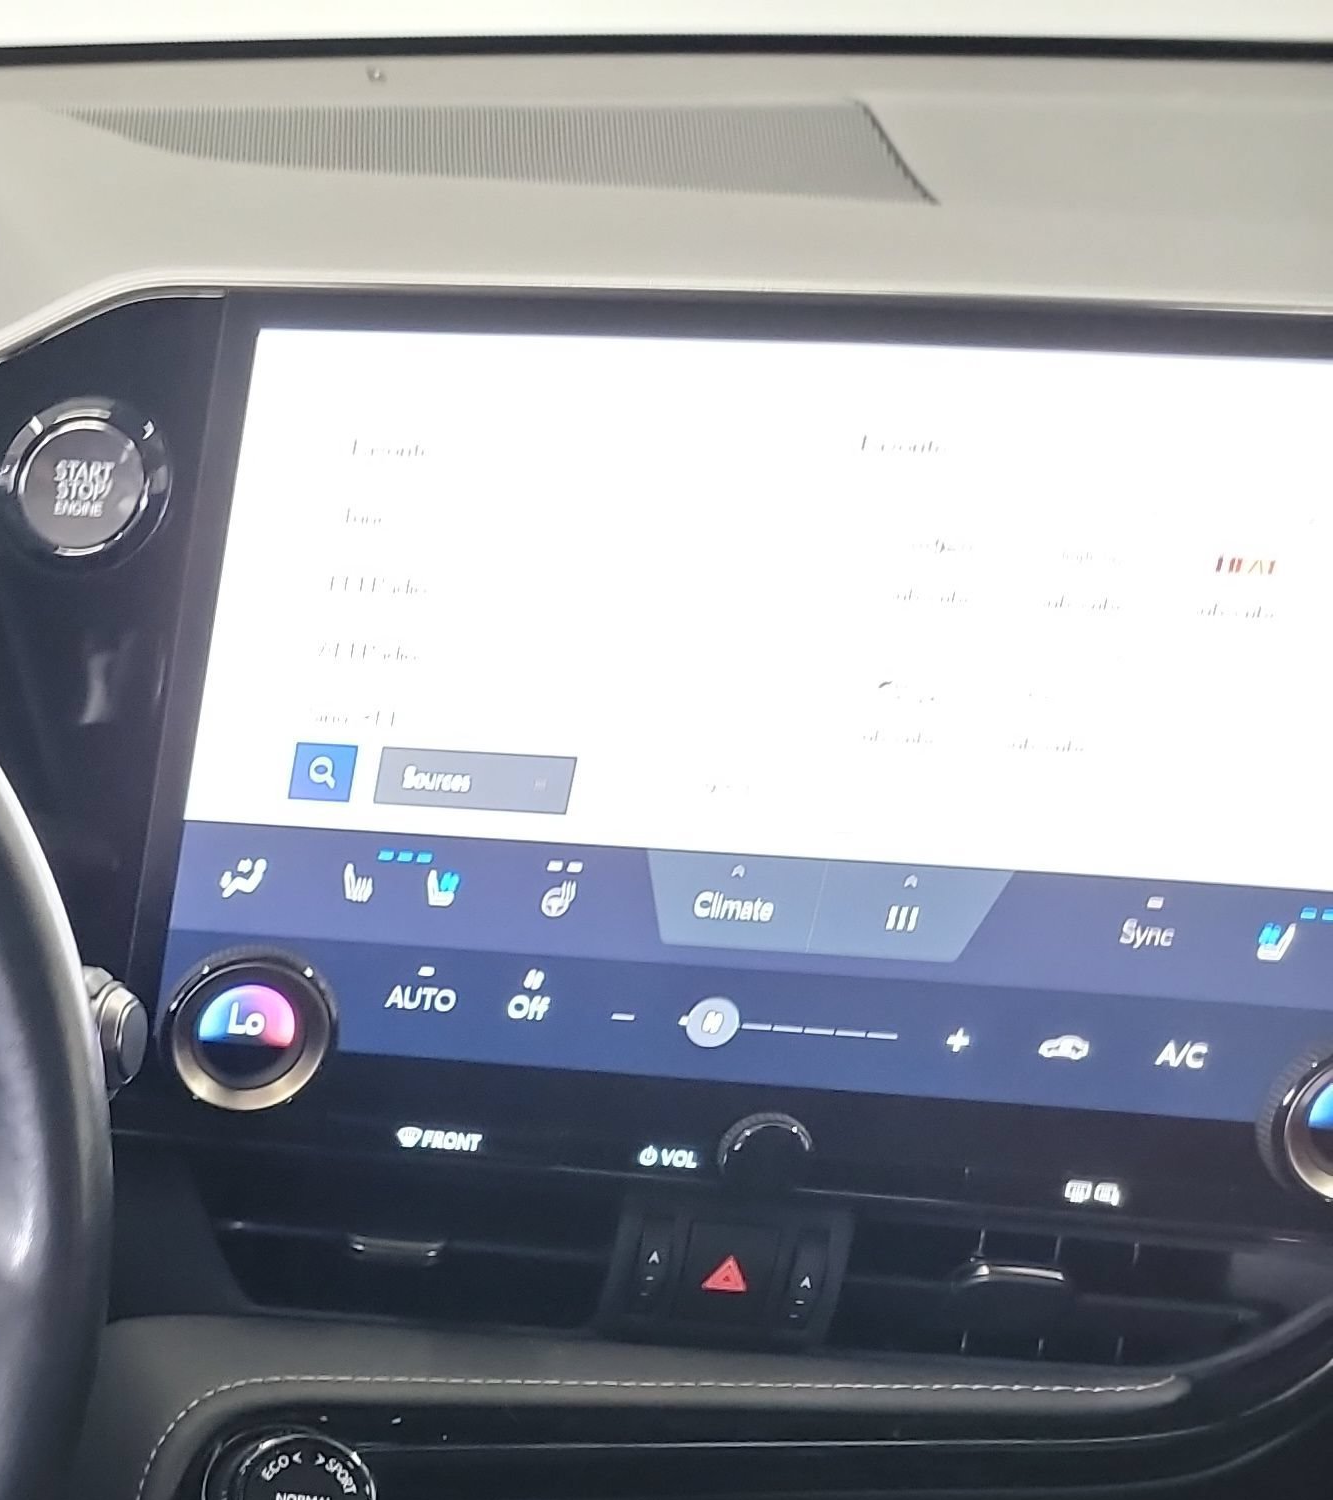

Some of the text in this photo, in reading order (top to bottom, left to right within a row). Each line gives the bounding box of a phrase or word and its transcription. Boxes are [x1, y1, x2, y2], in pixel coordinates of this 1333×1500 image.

[53, 459, 116, 483] START
[53, 500, 104, 517] ENGINE
[401, 764, 473, 793] Sources
[693, 889, 775, 923] Climate
[1118, 918, 1176, 949] Sync
[385, 984, 458, 1013] AUTO
[506, 993, 552, 1022] Off
[227, 1002, 265, 1036] Lo
[1154, 1039, 1210, 1070] A/C
[420, 1130, 483, 1152] FRONT
[660, 1148, 698, 1170] VOL
[261, 1454, 290, 1481] ECO
[325, 1457, 358, 1494] SPORT
